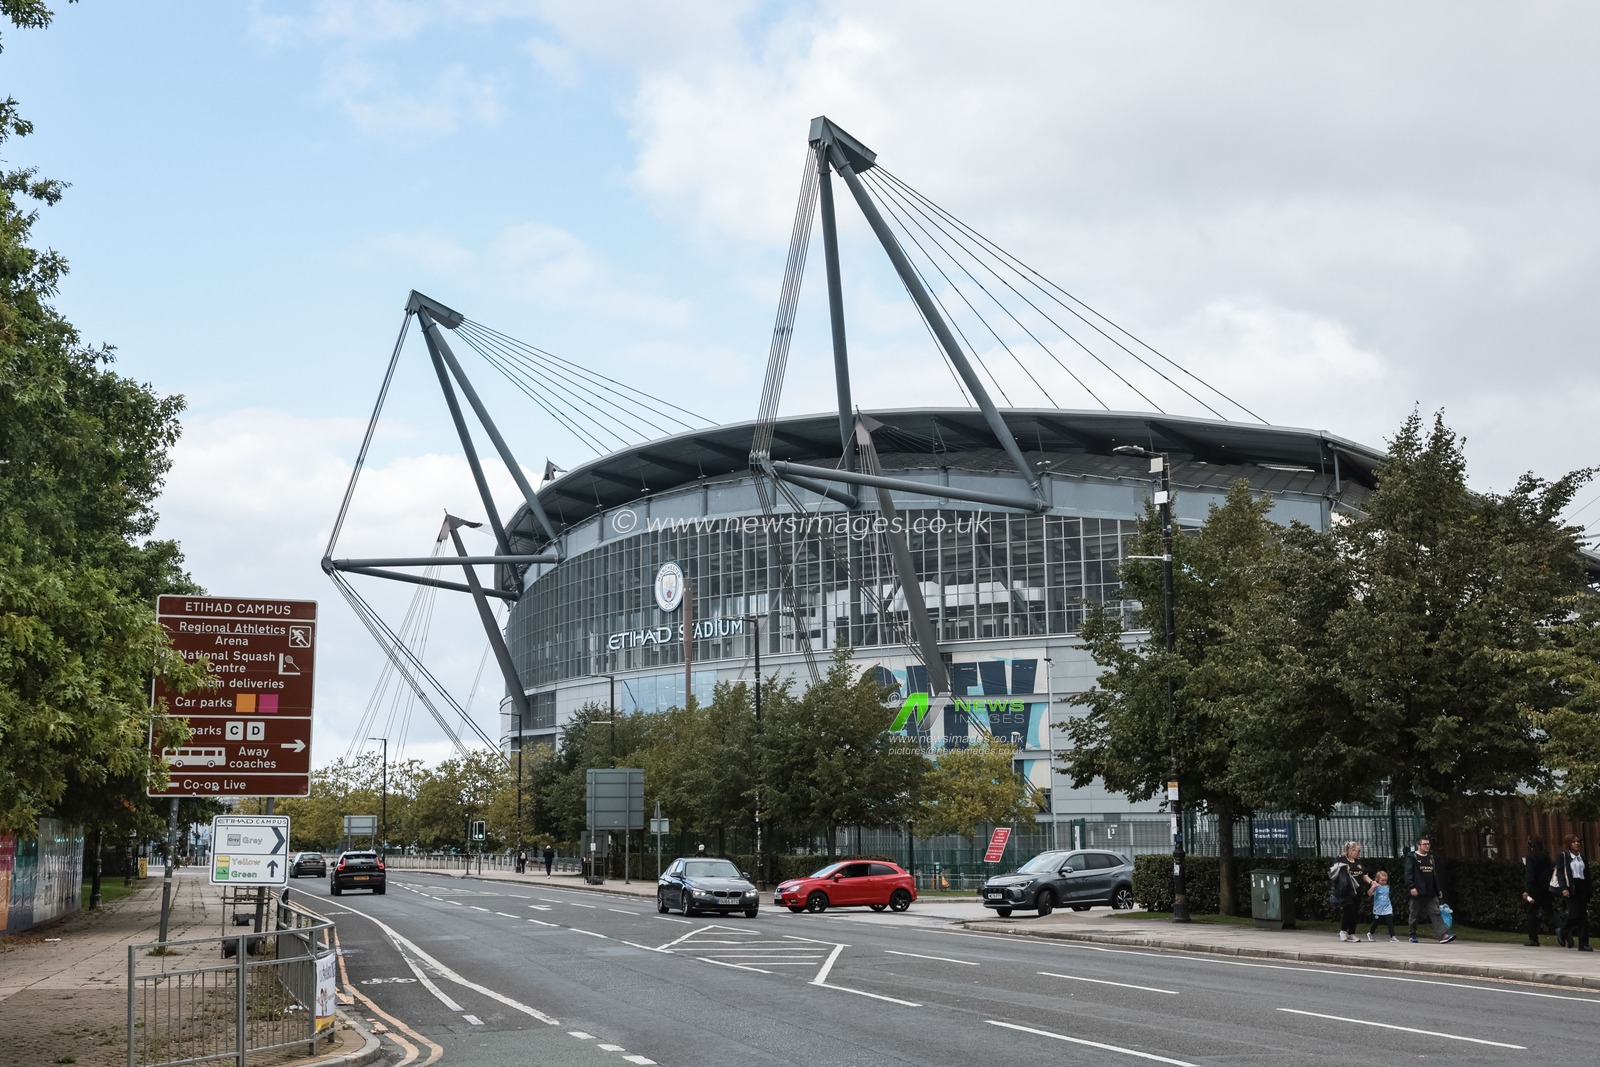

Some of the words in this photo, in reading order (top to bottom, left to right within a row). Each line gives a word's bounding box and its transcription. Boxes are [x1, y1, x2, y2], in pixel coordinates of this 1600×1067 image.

[185, 602, 232, 613] ETIHAD
[237, 603, 291, 615] CAMPUS
[179, 621, 230, 634] Regional
[234, 623, 286, 634] Athletics
[608, 626, 672, 650] ETIHAD
[679, 618, 743, 641] SADIUM
[215, 635, 249, 646] Arena
[179, 650, 229, 660] National
[233, 651, 276, 663] Squash
[206, 662, 246, 673] Centre
[229, 679, 285, 689] deliveries
[175, 697, 197, 707] Car
[200, 697, 233, 709] parks
[230, 725, 239, 735] C
[251, 725, 260, 735] D
[238, 747, 269, 758] Away
[229, 759, 277, 769] coaches
[183, 779, 219, 791] Co-op
[223, 779, 247, 790] Live
[242, 836, 263, 845] Grey
[231, 858, 261, 866] Yellow
[231, 870, 258, 878] Green
